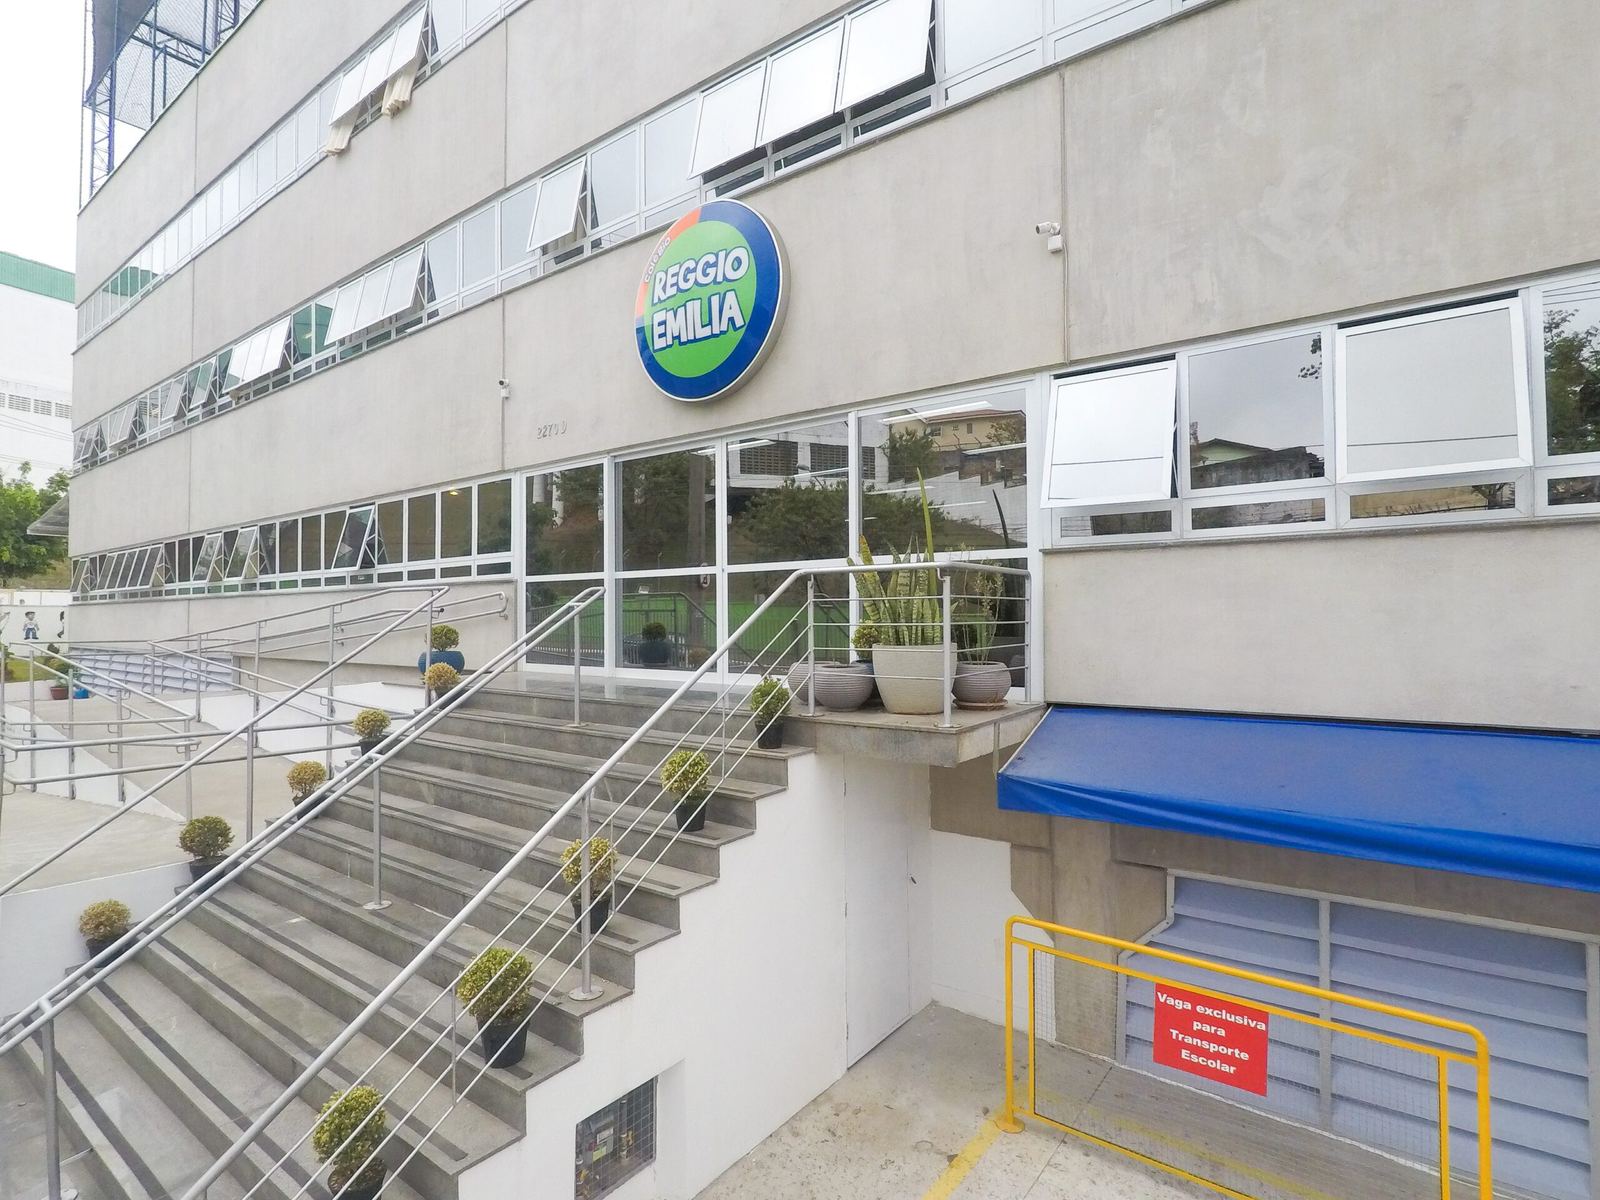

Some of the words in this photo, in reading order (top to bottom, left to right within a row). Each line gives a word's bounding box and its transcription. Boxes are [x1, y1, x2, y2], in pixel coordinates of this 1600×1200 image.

[653, 247, 749, 305] REGGIO
[652, 290, 745, 351] EMILIA
[1157, 991, 1192, 1010] Vaga
[1196, 1004, 1266, 1031] exclusiva
[1193, 1020, 1226, 1037] para
[1169, 1028, 1249, 1061] Transporte
[1181, 1048, 1237, 1075] Escolar
